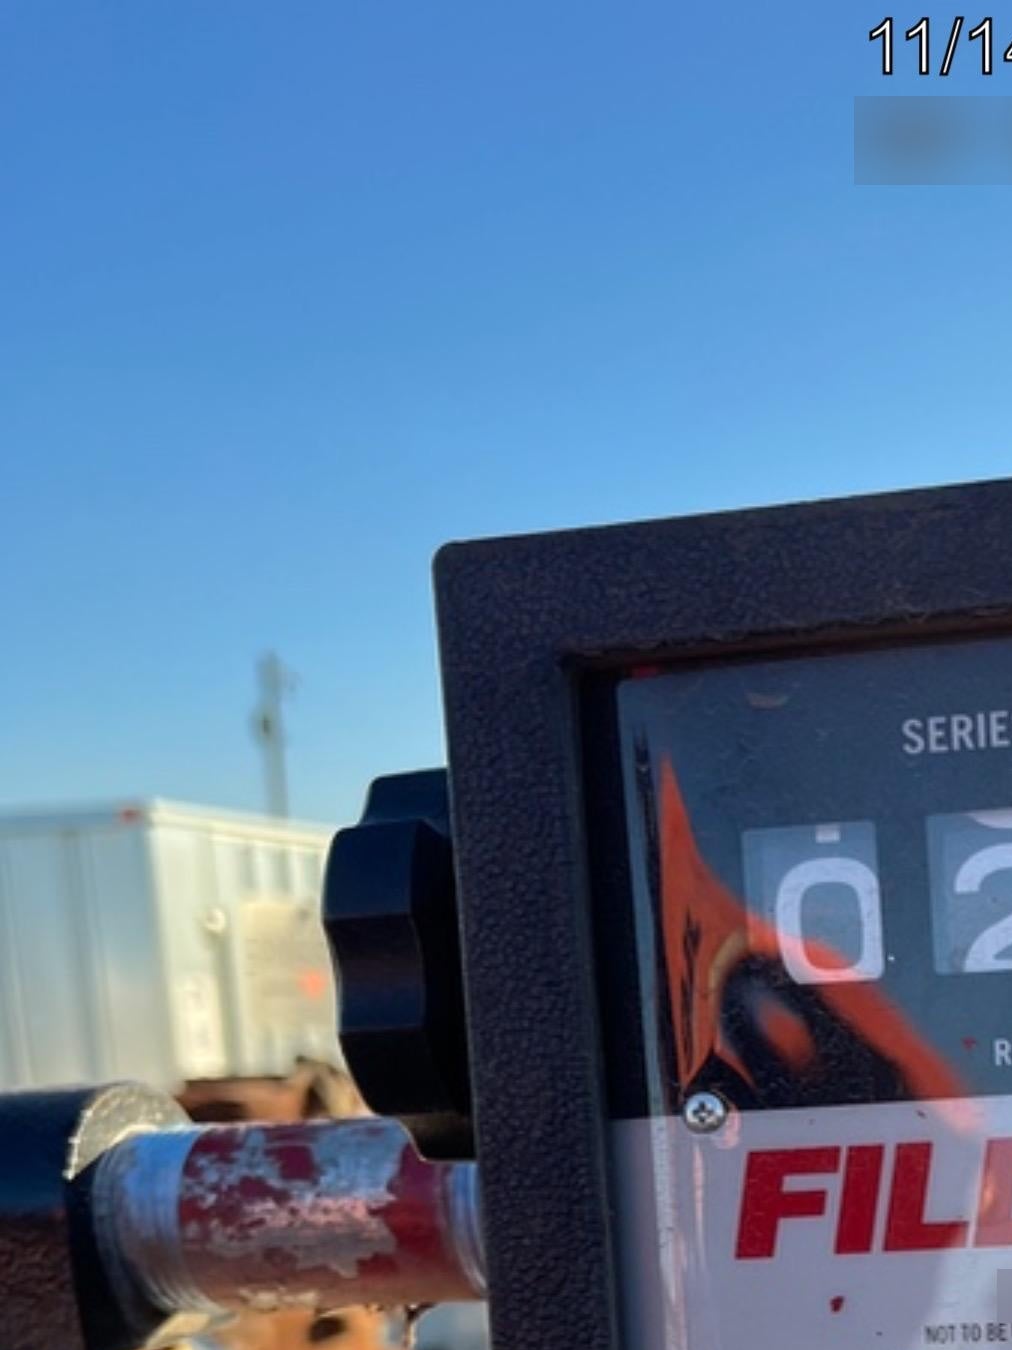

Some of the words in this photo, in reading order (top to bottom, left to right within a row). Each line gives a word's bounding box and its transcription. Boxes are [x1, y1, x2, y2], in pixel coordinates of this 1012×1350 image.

[926, 1326, 956, 1344] NOT
[961, 1324, 982, 1342] TO
[986, 1322, 1006, 1342] BE
